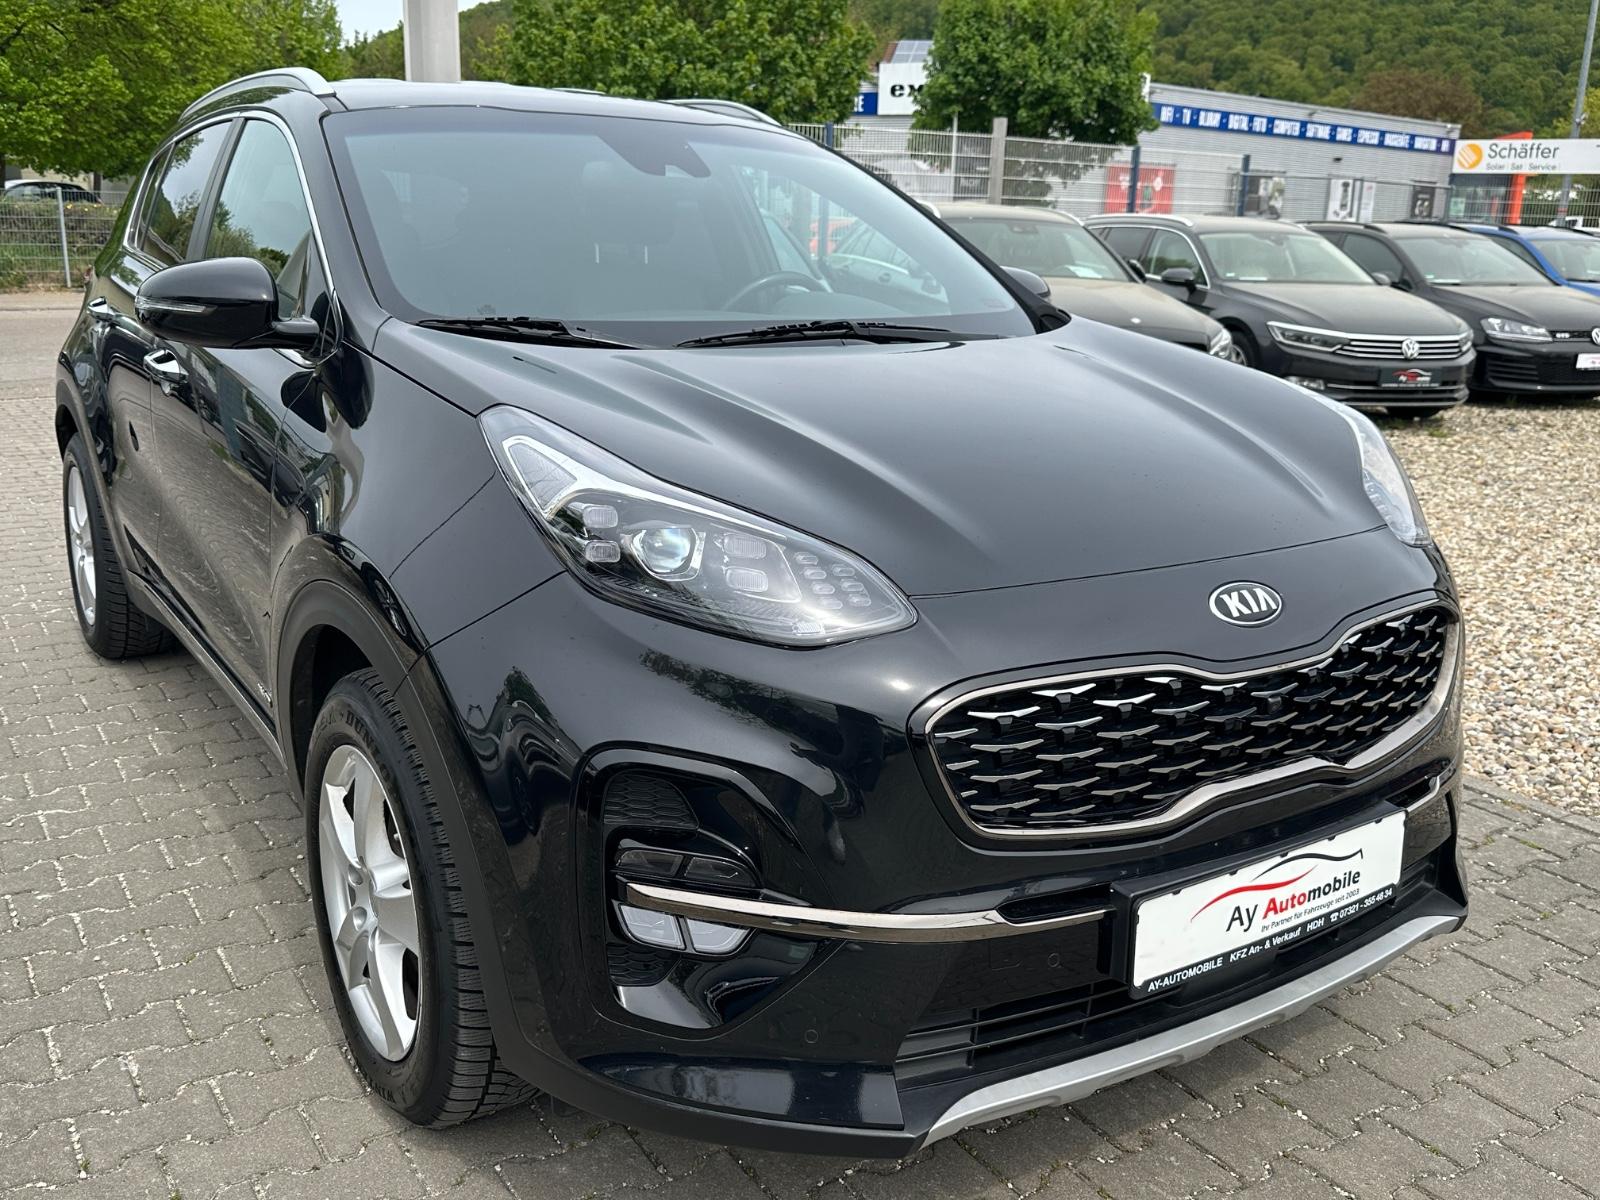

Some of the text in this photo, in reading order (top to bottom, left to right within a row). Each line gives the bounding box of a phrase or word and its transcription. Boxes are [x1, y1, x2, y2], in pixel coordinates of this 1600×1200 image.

[1182, 108, 1192, 125] TV
[1273, 119, 1300, 136] COMPUTER
[1487, 143, 1560, 159] Schäffer
[1486, 163, 1557, 171] Solar Sat Service
[1219, 587, 1278, 618] KIA
[1225, 870, 1361, 932] Ay Automobile
[1261, 888, 1360, 933] Ihr Partner für Fahrzeuge seit 2003
[1147, 956, 1224, 993] AY-AUTOMOBILE
[1229, 949, 1248, 963] KFZ
[1248, 945, 1263, 957] An-
[1264, 940, 1271, 949] &
[1272, 926, 1302, 946] Verkauf
[1306, 917, 1325, 932] HDH
[1339, 901, 1360, 919] 07321
